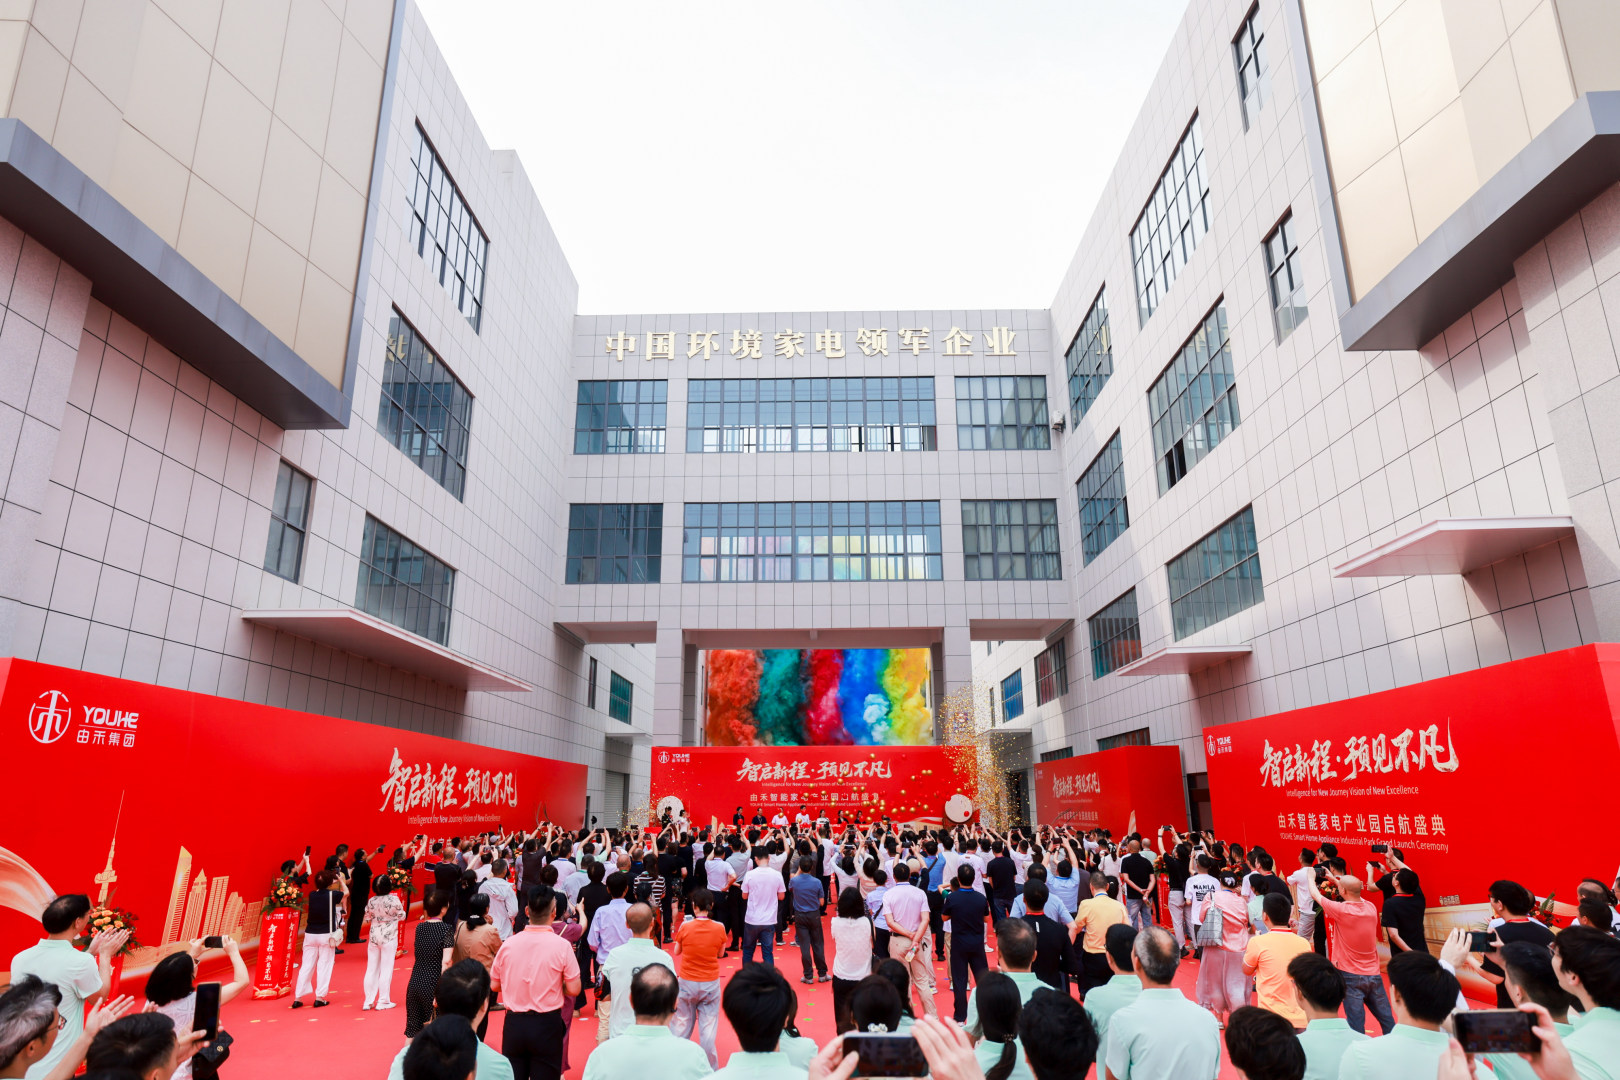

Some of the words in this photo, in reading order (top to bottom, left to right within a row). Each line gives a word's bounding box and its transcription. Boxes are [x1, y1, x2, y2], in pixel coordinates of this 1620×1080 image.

[606, 326, 1018, 361] 中国环境家电领军企业
[83, 705, 139, 728] YOUHE
[76, 729, 136, 748] 由禾集团
[1318, 788, 1329, 796] New
[1330, 788, 1348, 798] Journey
[1349, 787, 1365, 796] Vision
[1366, 786, 1372, 796] of
[1372, 786, 1385, 795] New
[1386, 785, 1419, 795] Excellence
[1278, 812, 1446, 837] 由禾智能家电产业园启航盛典
[1364, 837, 1376, 846] Park
[1394, 839, 1415, 849] Launch
[1416, 841, 1449, 854] Ceremony
